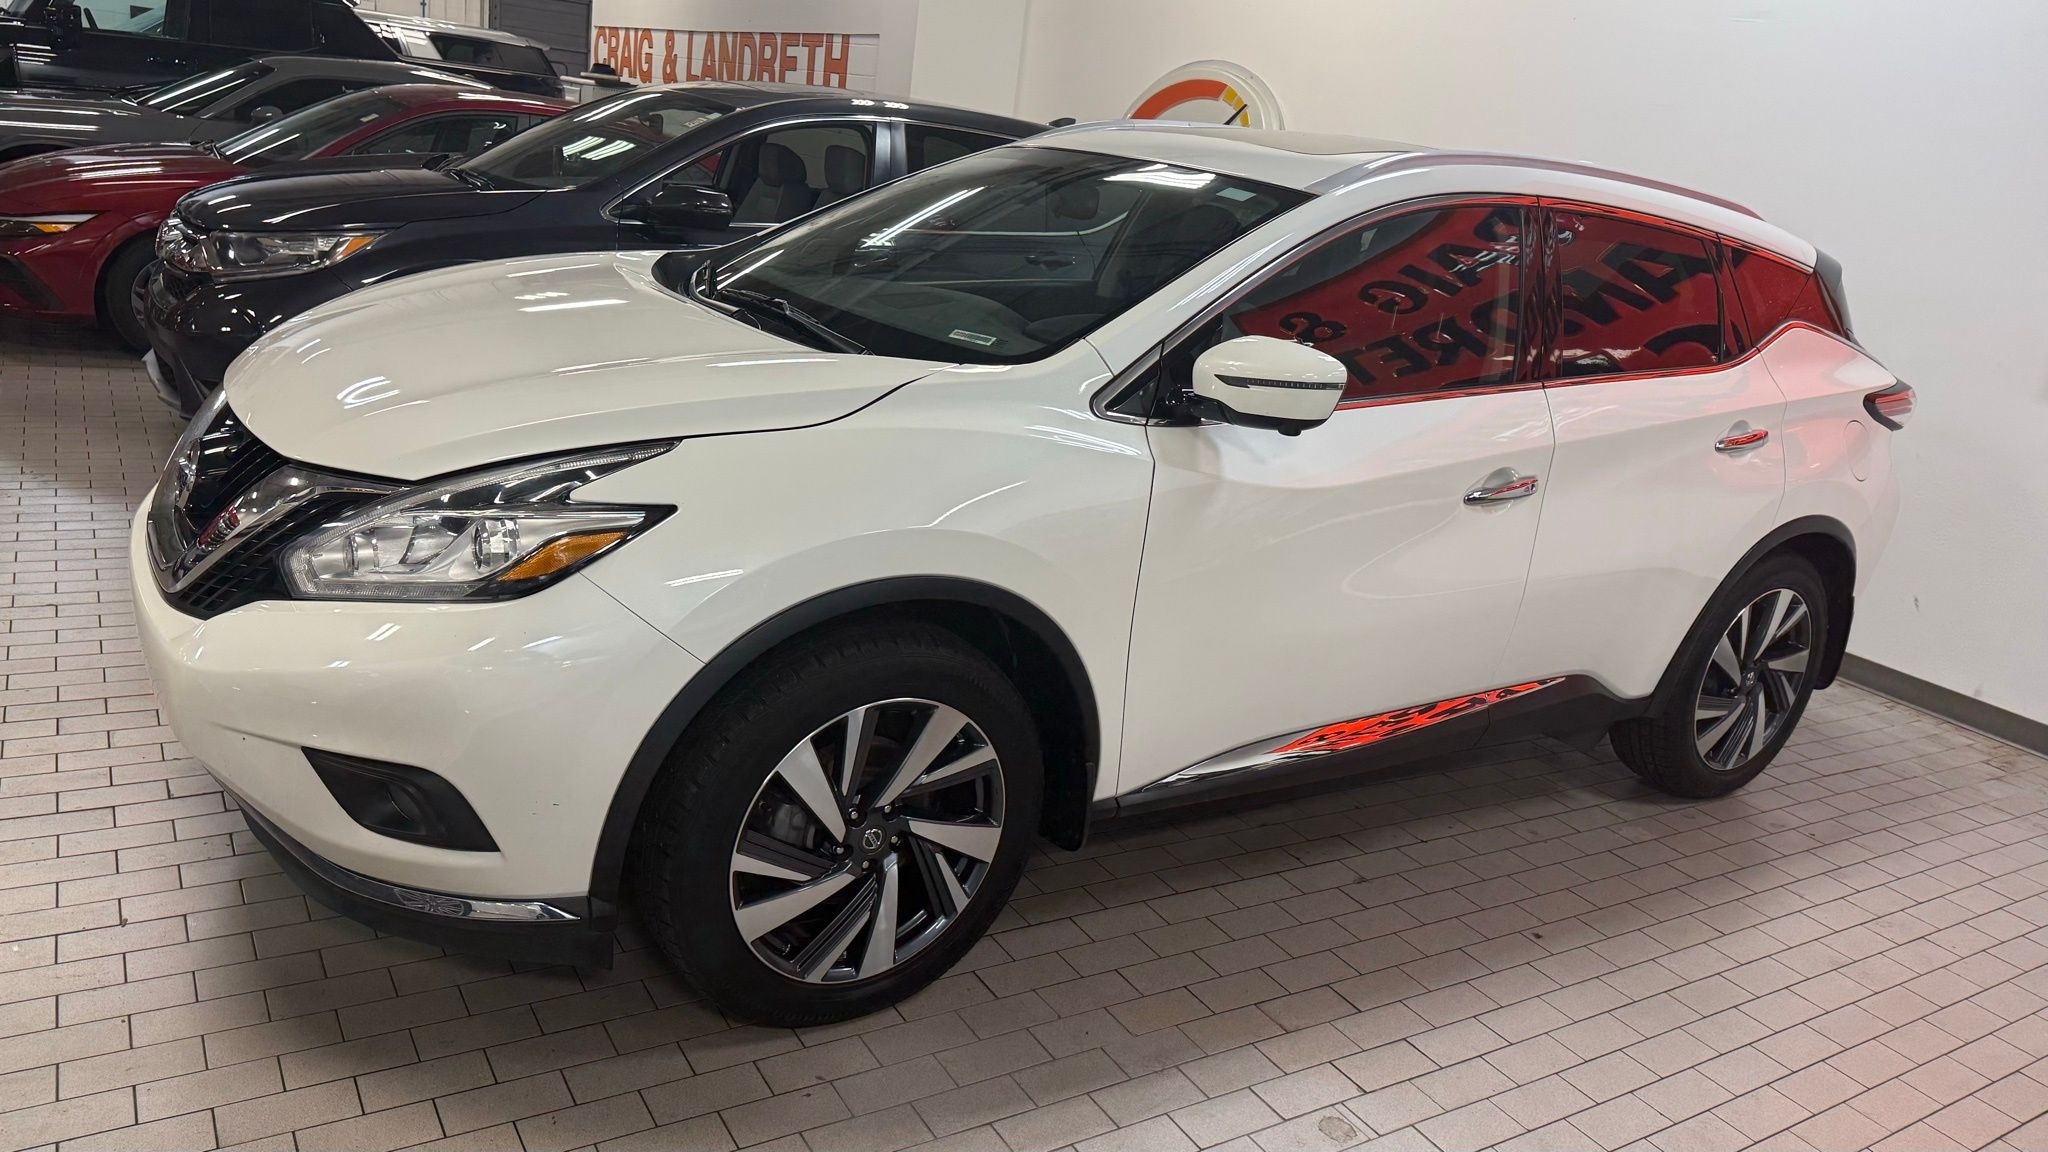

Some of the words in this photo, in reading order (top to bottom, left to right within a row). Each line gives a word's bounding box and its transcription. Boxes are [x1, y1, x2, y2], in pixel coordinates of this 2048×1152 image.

[594, 27, 653, 84] CRAIG
[662, 29, 678, 84] &
[686, 31, 850, 89] LANDRETH
